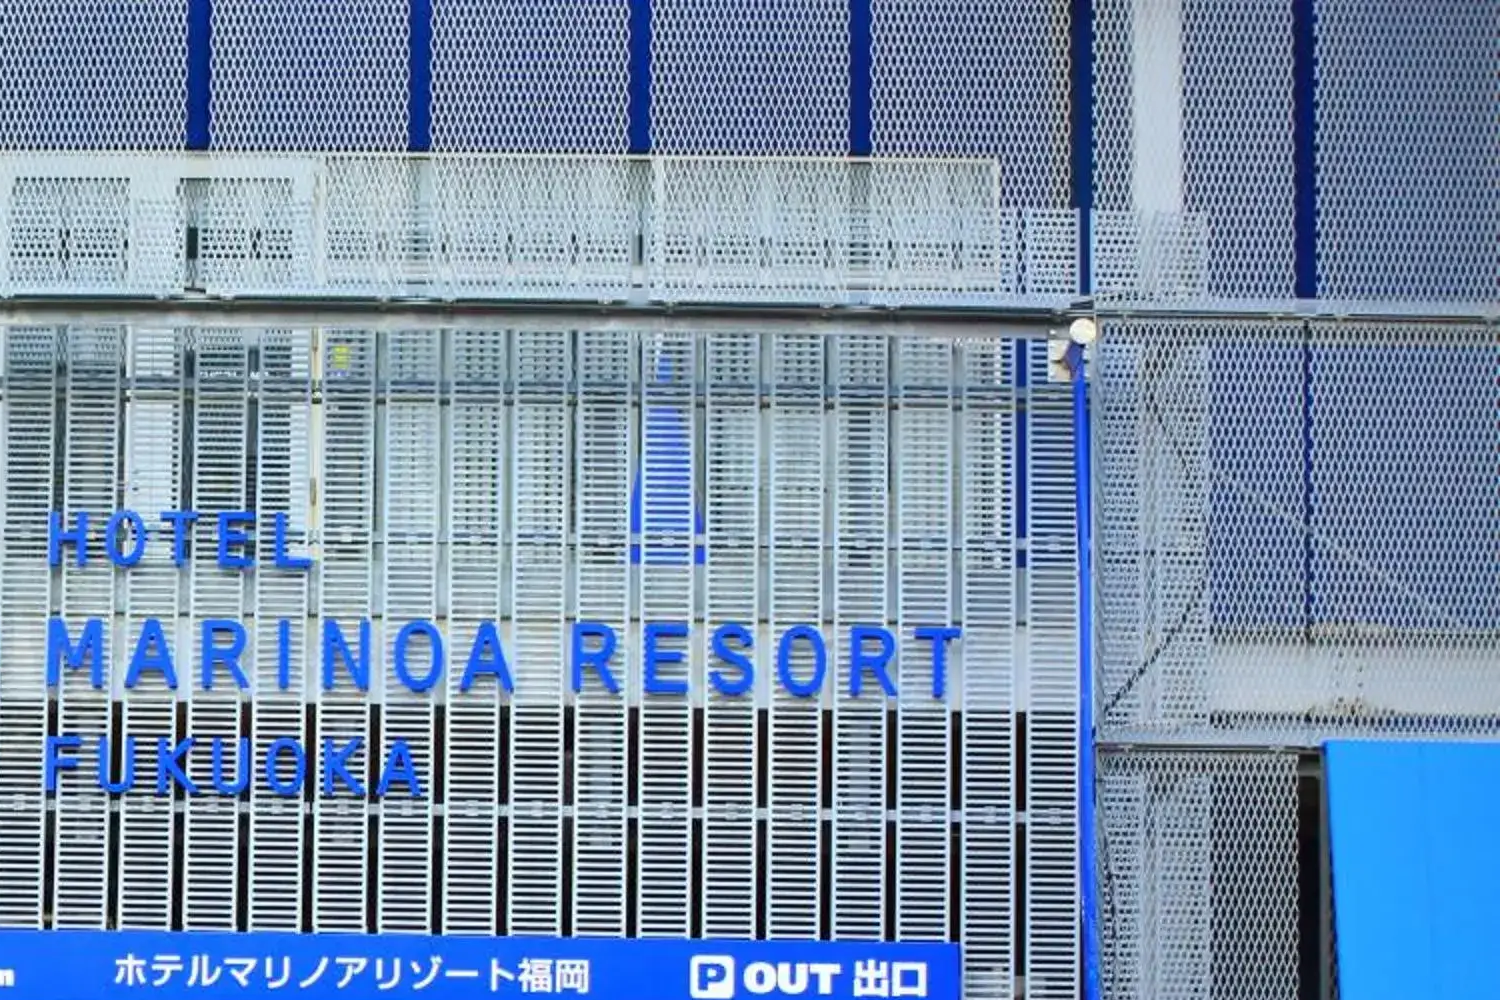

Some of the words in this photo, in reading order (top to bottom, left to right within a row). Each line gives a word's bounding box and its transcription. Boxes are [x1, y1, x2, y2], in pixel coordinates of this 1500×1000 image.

[47, 510, 313, 569] HOTEL
[45, 616, 514, 694] MARINOA
[571, 620, 962, 698] RESORT
[44, 734, 422, 797] FUKUOKA
[114, 953, 591, 994] ホテルマリノアリゾート福岡
[743, 961, 841, 995] OUT
[853, 958, 928, 998] 出口
